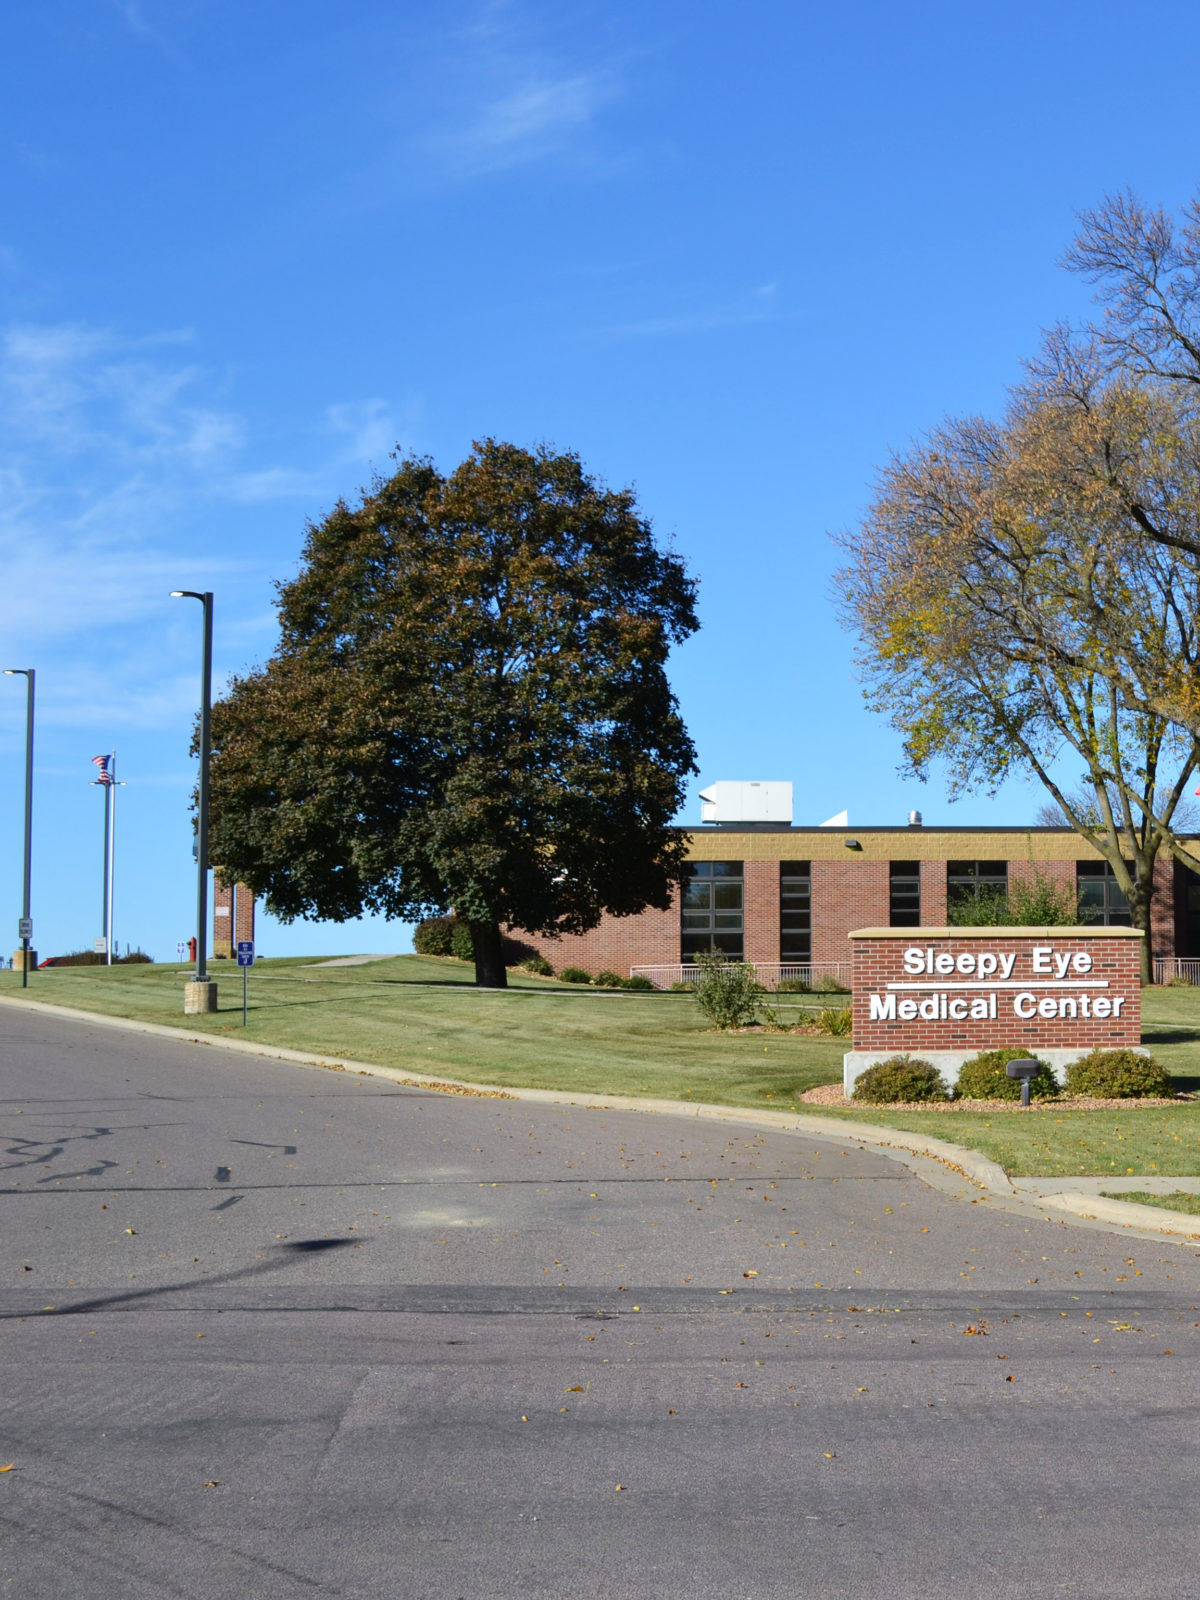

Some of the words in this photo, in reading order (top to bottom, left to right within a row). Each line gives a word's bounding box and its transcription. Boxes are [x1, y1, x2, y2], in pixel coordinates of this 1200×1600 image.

[903, 947, 1016, 979] Sleepy
[1032, 947, 1093, 979] Eye
[869, 993, 998, 1021] Medical
[1013, 992, 1126, 1019] Center
